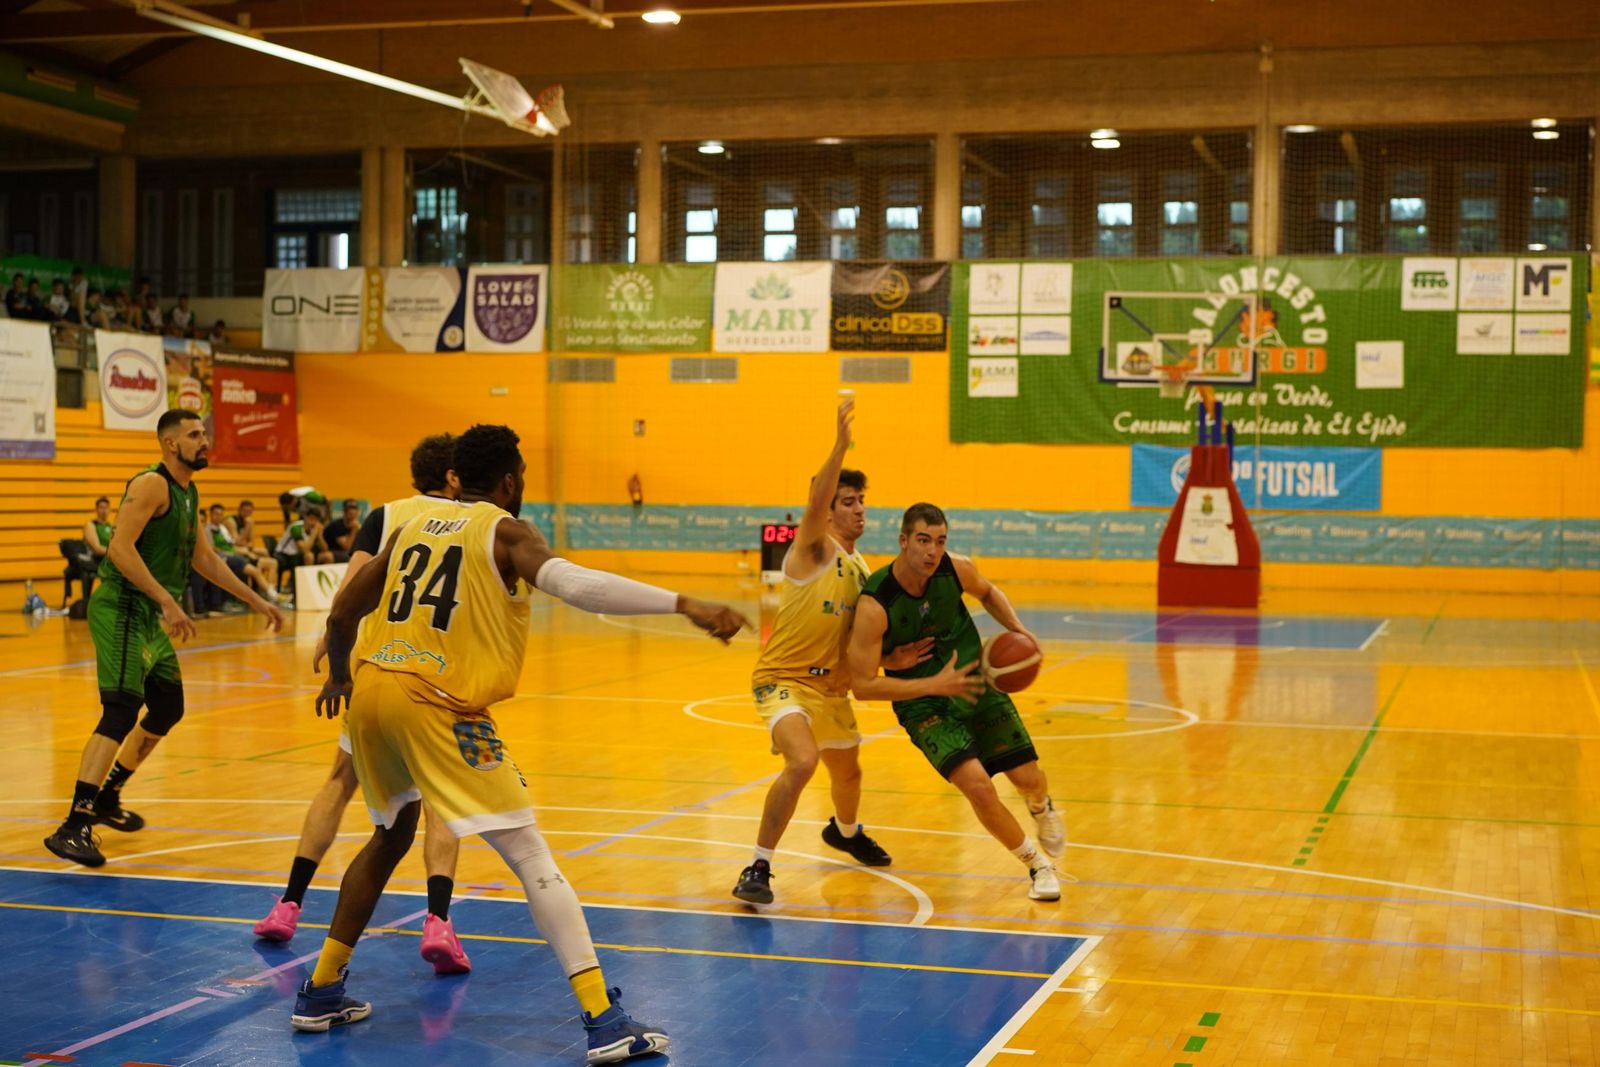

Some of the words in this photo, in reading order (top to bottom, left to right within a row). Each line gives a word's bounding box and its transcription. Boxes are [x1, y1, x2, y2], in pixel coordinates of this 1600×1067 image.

[477, 281, 523, 293] LOVE
[271, 295, 359, 315] ONE
[476, 294, 535, 306] SALAD
[572, 316, 609, 329] Verde
[668, 315, 705, 330] Color
[724, 308, 817, 332] MARY
[616, 331, 699, 346] Sentimiento
[1113, 411, 1191, 434] Consume
[1302, 414, 1322, 435] de
[1327, 412, 1352, 435] El
[1356, 411, 1407, 443] Ejido
[1256, 461, 1339, 497] FUTSAL
[387, 544, 463, 632] 34
